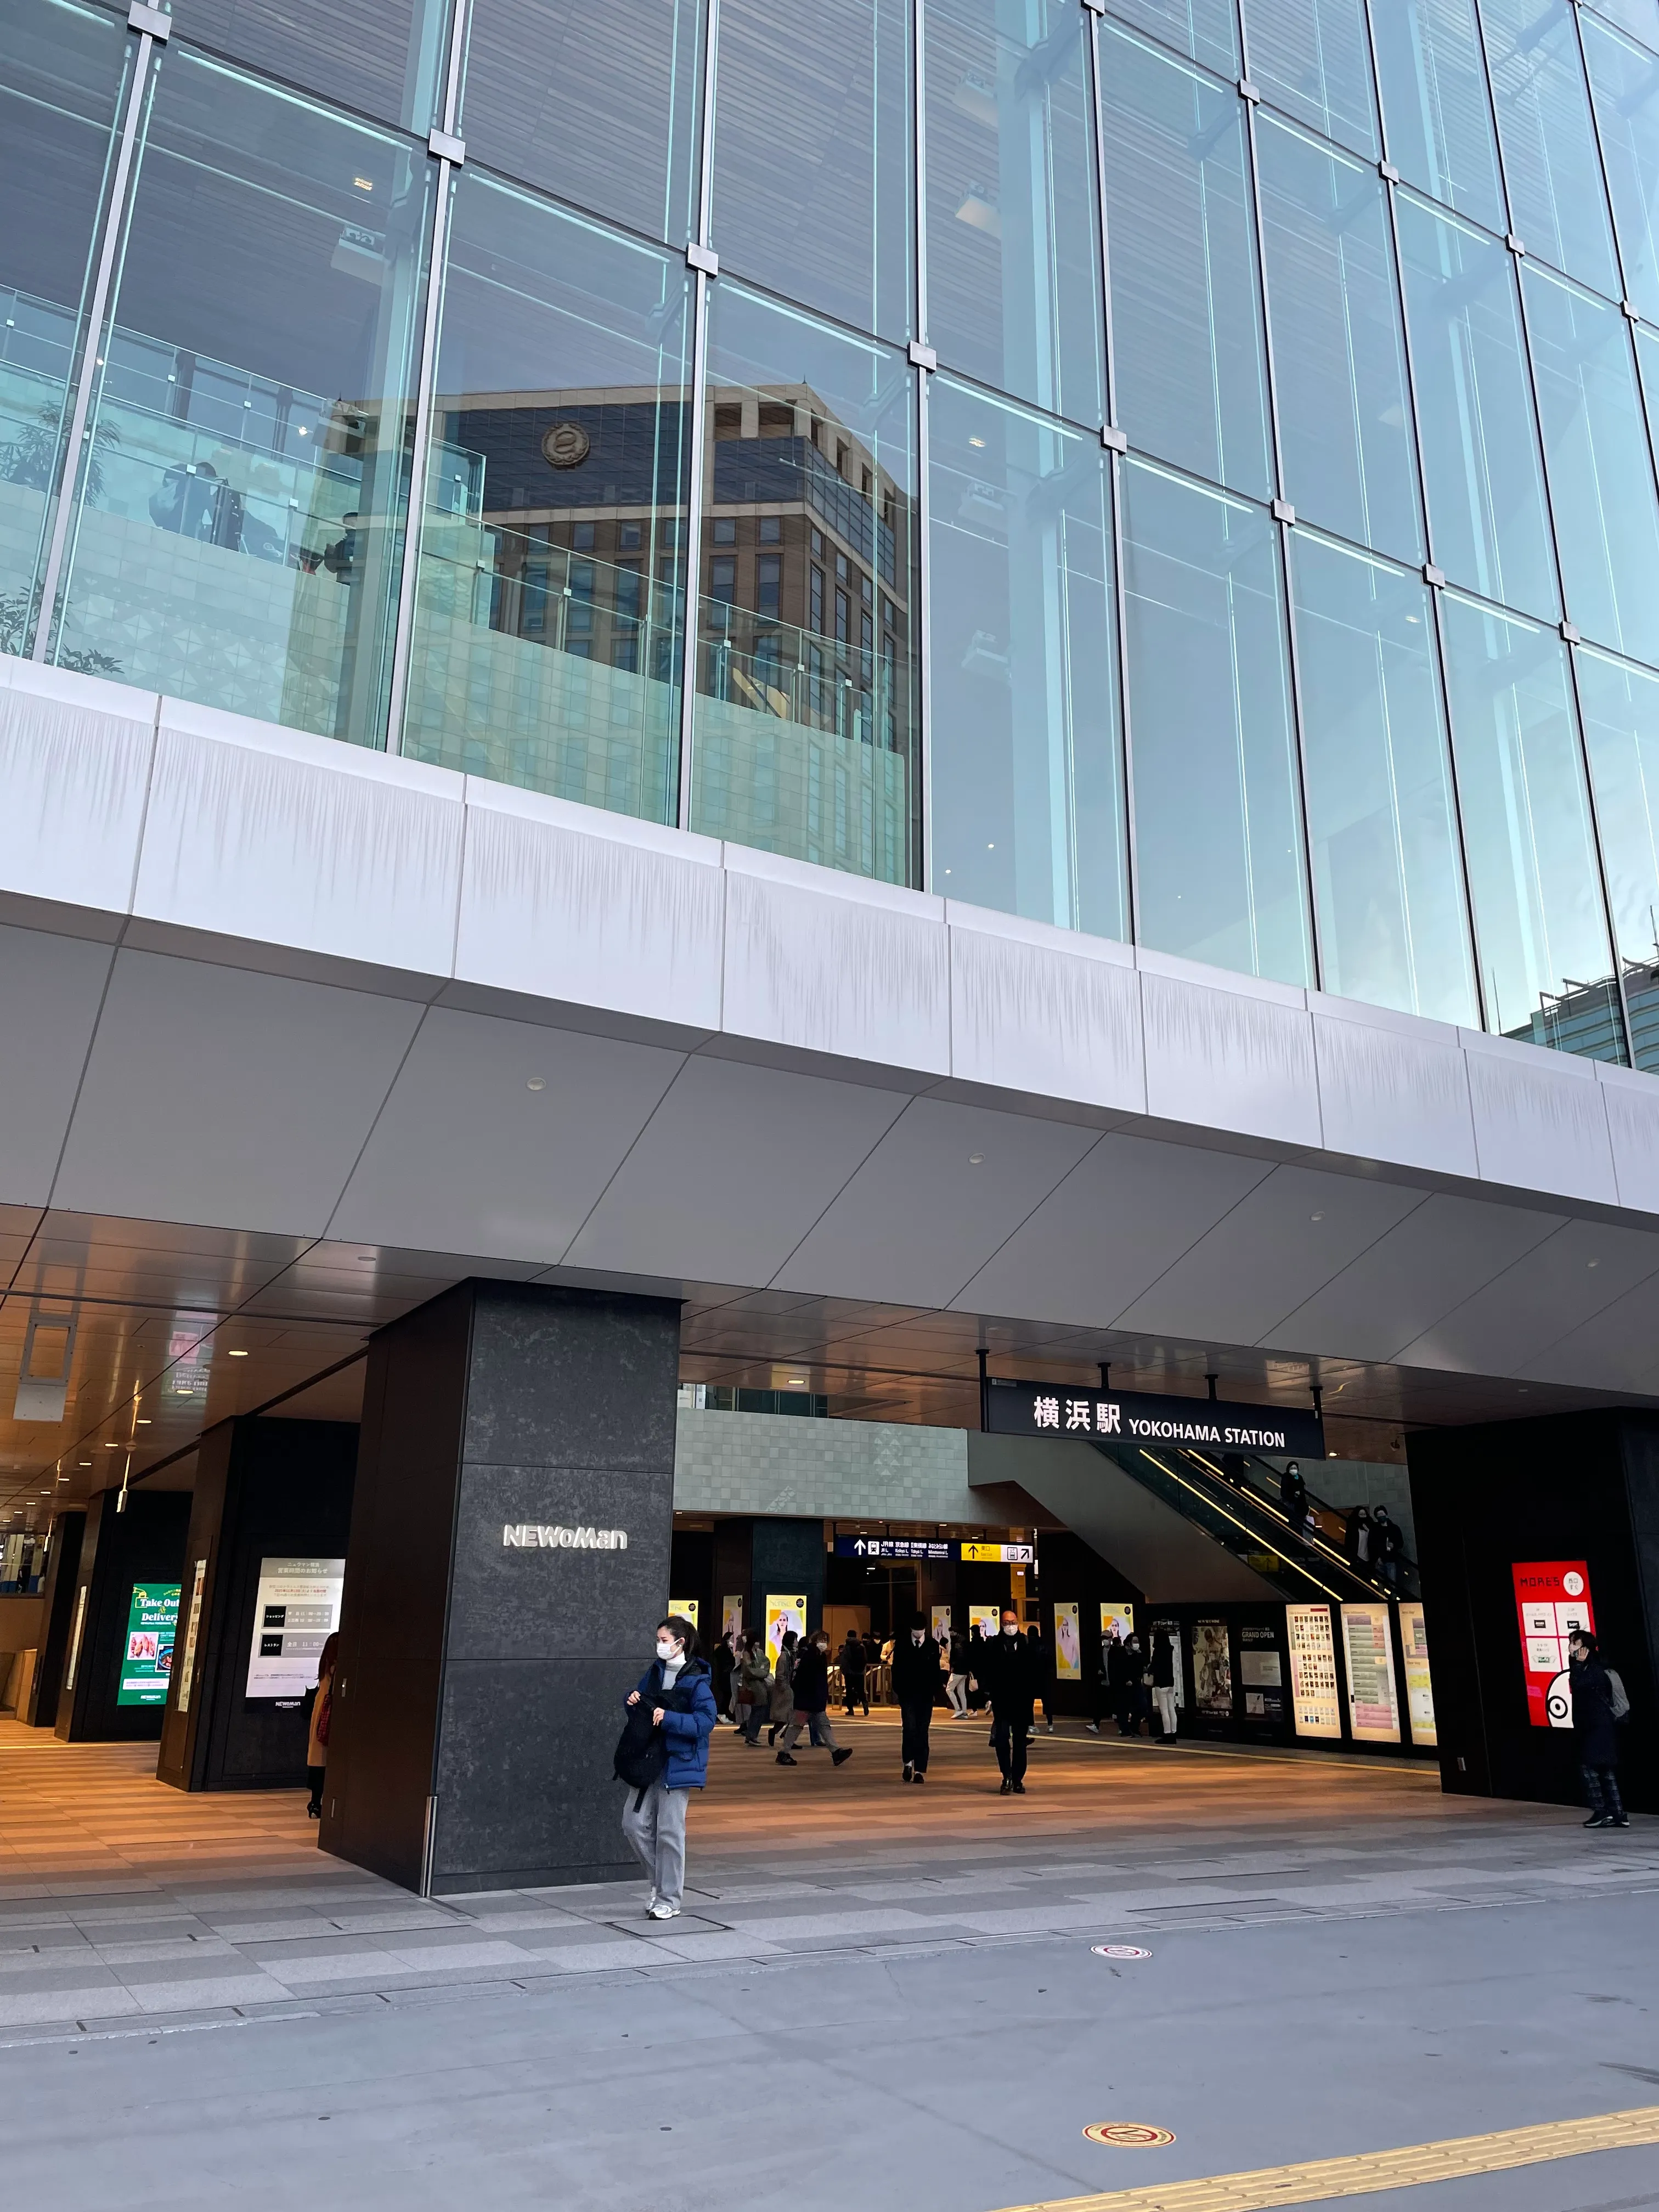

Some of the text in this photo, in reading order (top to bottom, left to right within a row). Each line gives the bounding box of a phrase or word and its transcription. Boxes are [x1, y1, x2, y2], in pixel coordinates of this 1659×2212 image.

[1034, 1396, 1121, 1434] 横浜駅
[1129, 1418, 1285, 1448] YOKOHAMA STATION
[503, 1524, 628, 1549] NEWoMan
[140, 1599, 180, 1607] Take Out
